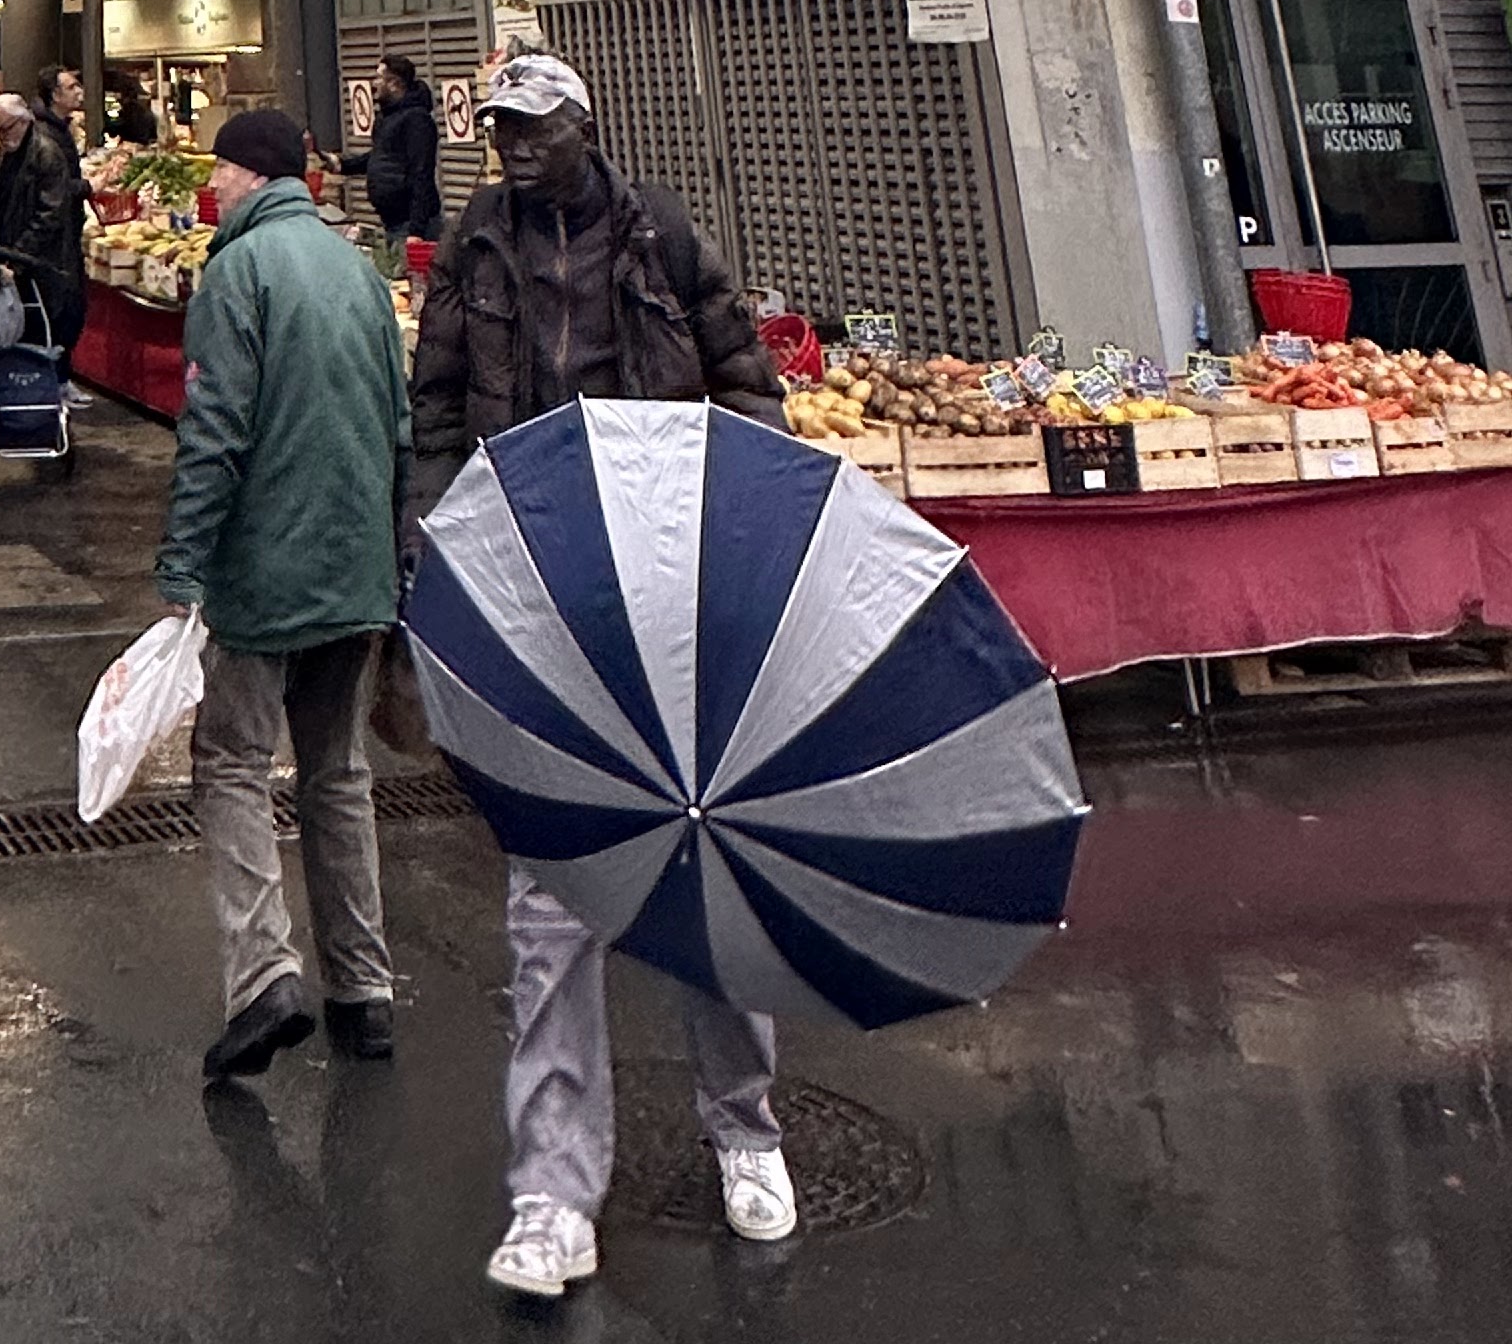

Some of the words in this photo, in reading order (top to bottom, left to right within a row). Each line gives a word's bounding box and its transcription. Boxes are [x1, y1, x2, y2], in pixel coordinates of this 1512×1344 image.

[1305, 102, 1349, 125] ACCES
[1351, 102, 1412, 125] PARKING
[1324, 129, 1404, 152] ASCENSEUR
